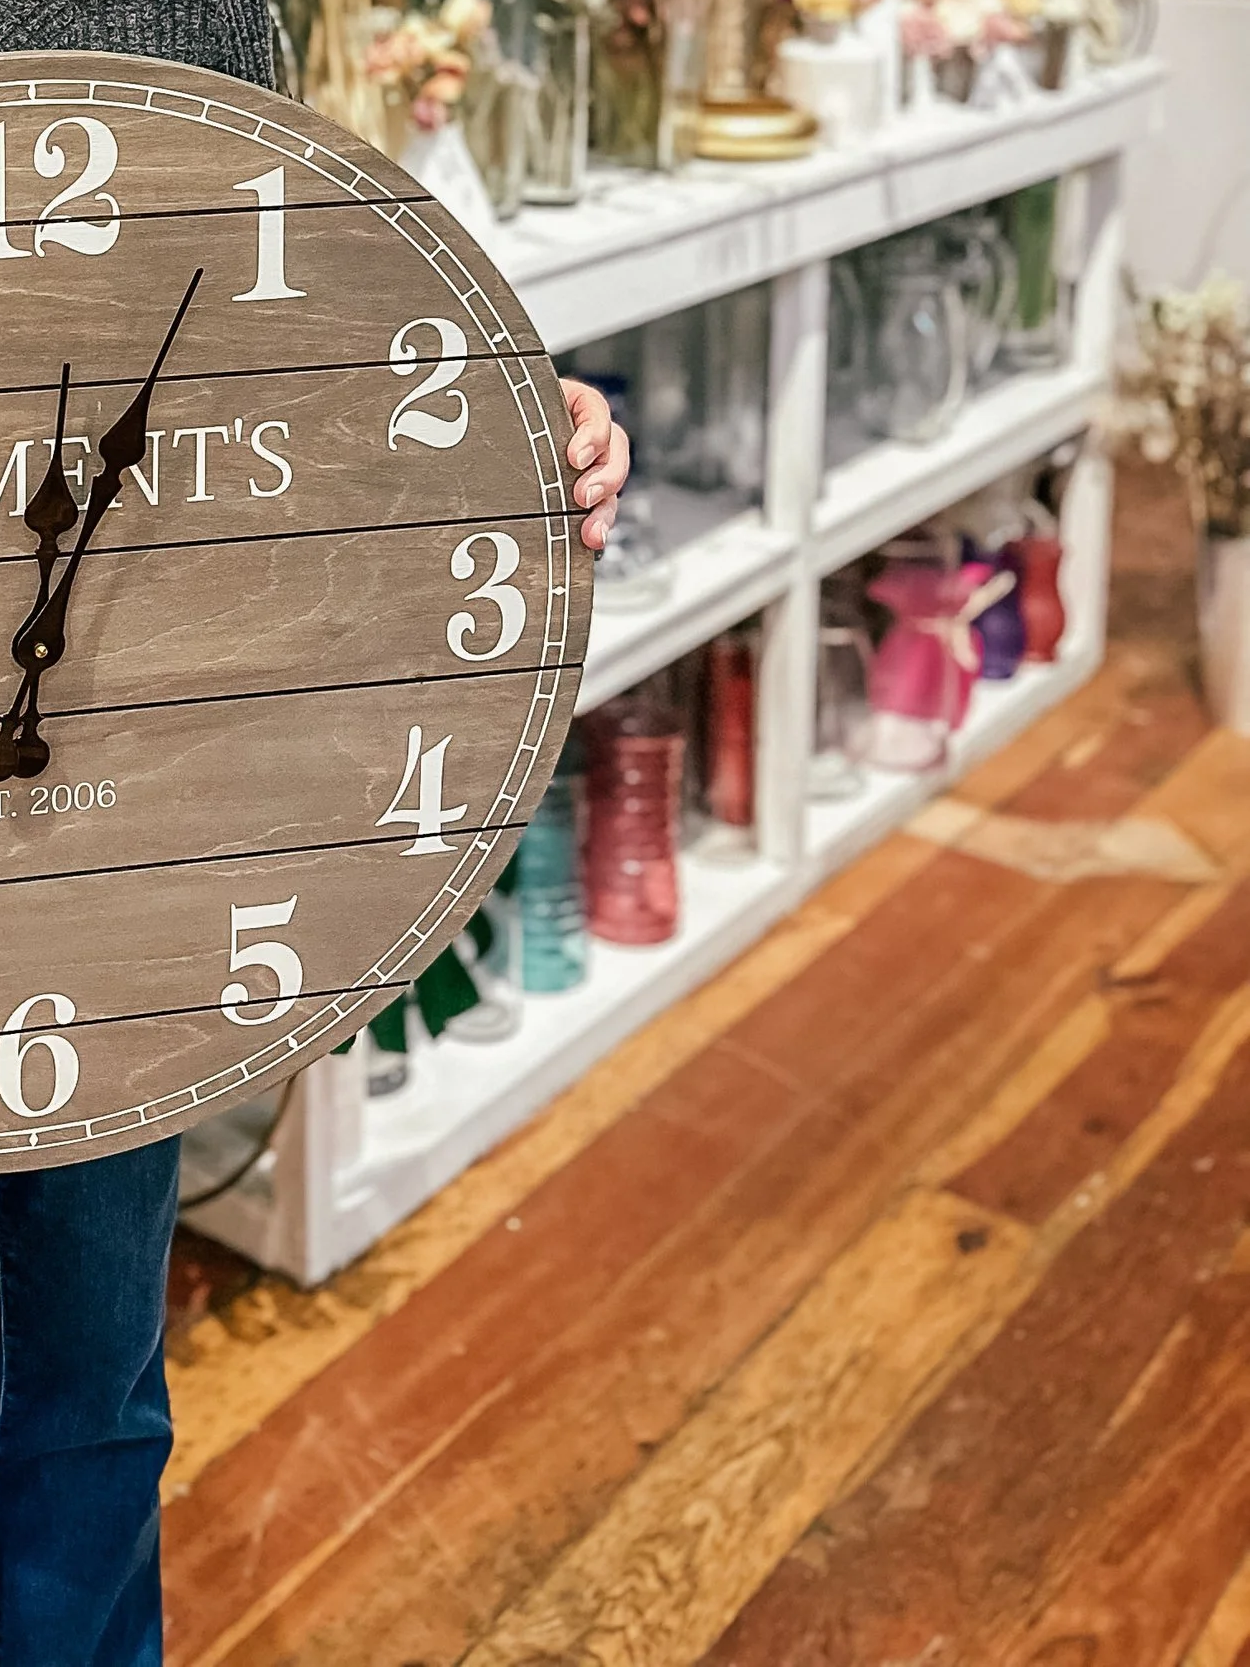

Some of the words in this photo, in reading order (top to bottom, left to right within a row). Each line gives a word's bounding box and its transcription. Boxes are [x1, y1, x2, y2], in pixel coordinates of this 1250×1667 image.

[232, 165, 307, 302] 1
[388, 317, 469, 451] 2
[447, 531, 527, 662] 3
[30, 779, 117, 815] 2006
[374, 725, 469, 857] 4
[220, 895, 304, 1027] 5
